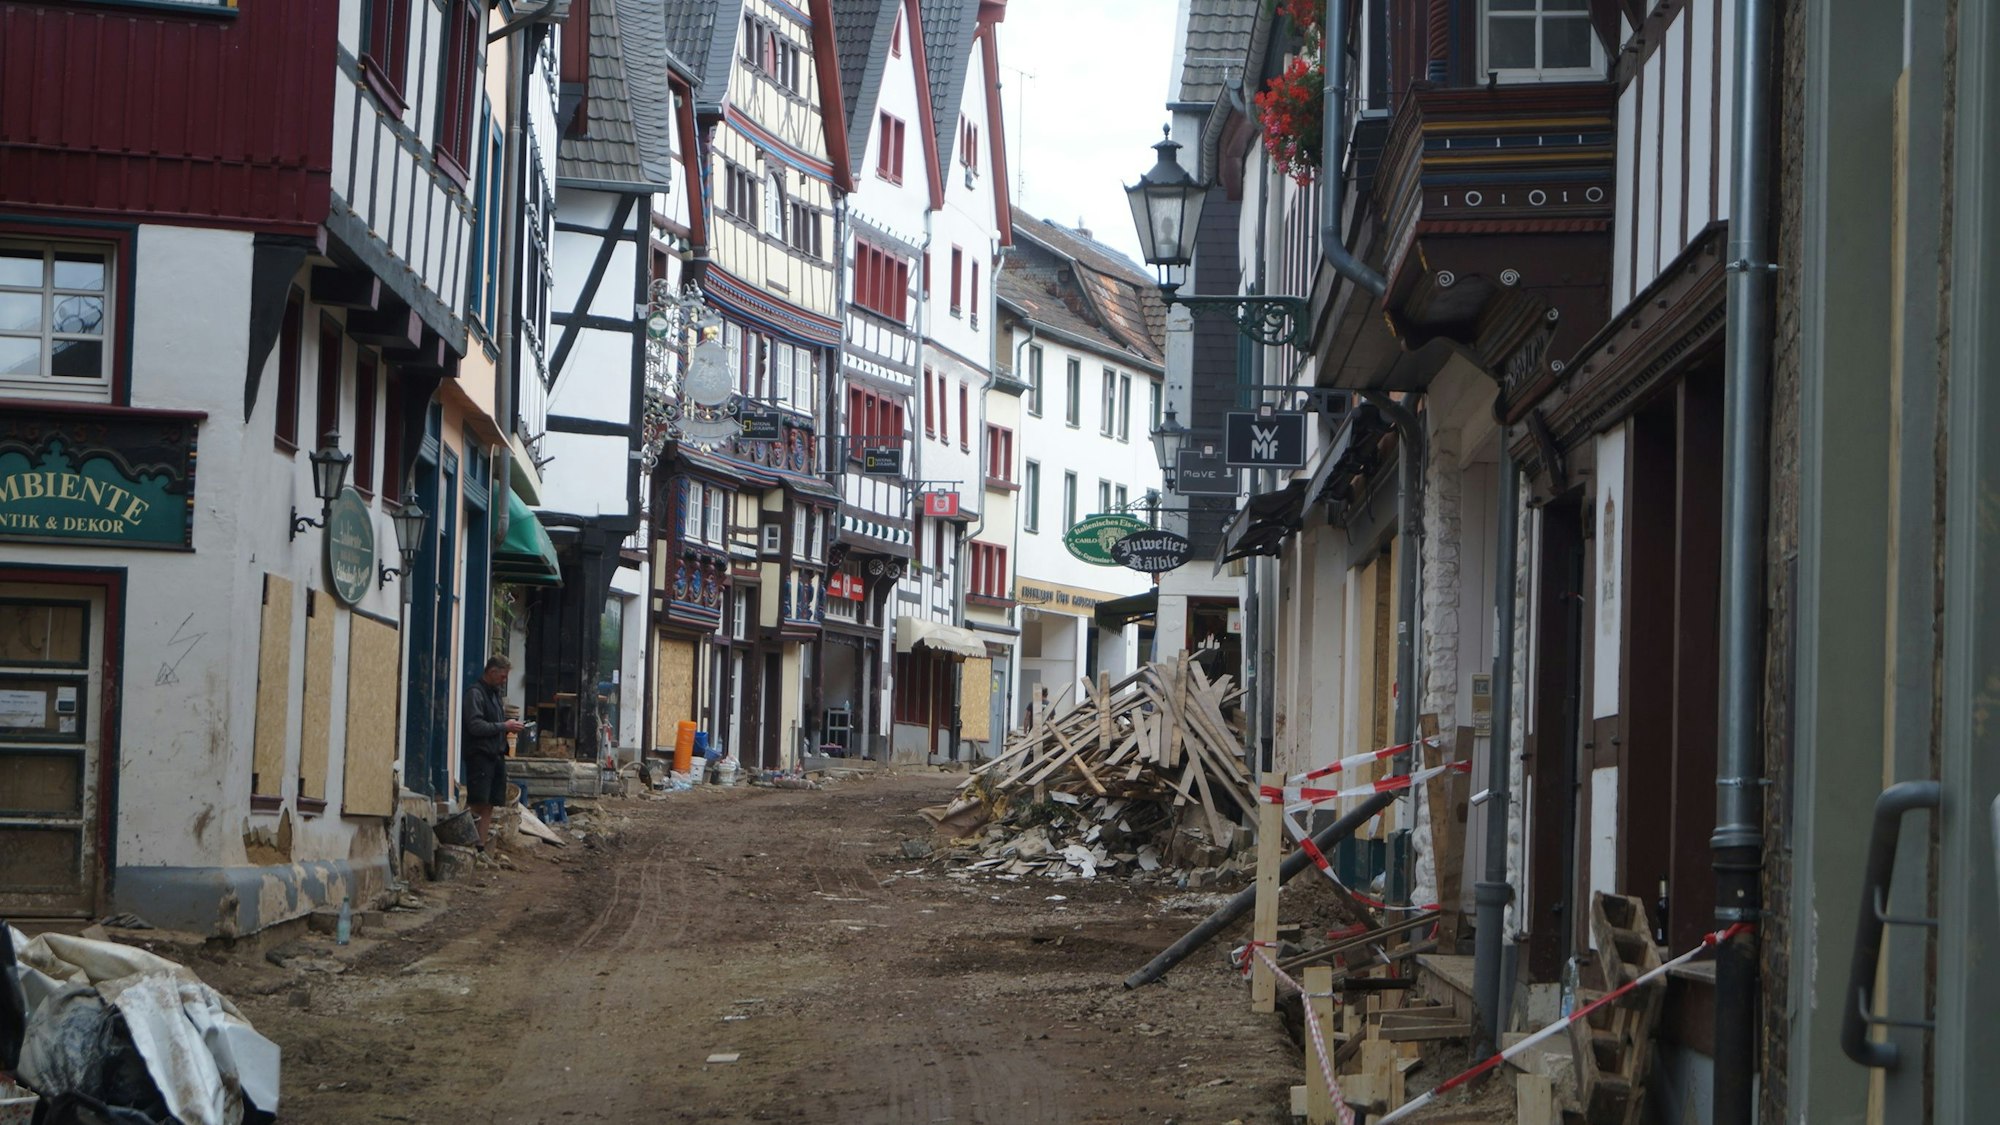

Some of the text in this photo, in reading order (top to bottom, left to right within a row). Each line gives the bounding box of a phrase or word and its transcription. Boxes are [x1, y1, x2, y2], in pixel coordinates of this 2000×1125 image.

[45, 516, 58, 530] &
[63, 516, 124, 533] DEKOR
[1074, 518, 1119, 536] Italienisches
[1117, 536, 1189, 557] Juwelier
[1128, 553, 1180, 570] Kälble
